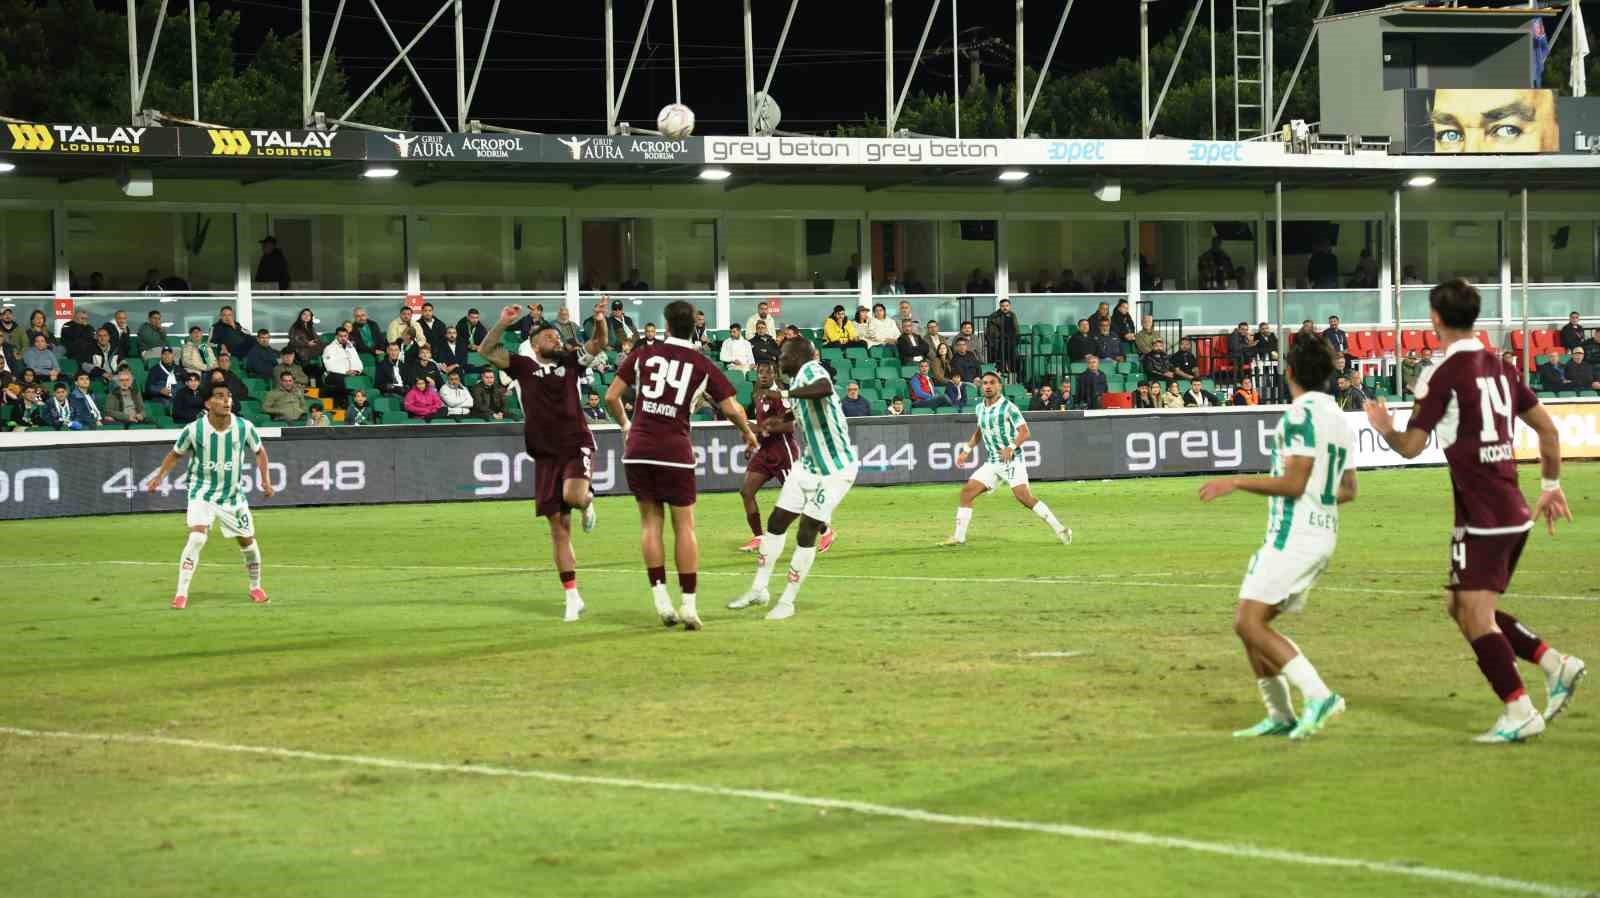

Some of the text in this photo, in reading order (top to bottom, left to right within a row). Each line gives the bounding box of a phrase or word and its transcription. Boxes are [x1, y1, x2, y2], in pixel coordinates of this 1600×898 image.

[53, 125, 147, 144] TALAY
[250, 130, 337, 148] TALAY
[60, 143, 141, 153] LOGISTICS
[257, 148, 332, 157] LOGISTICS
[412, 143, 456, 158] AURA
[461, 138, 524, 151] ACROPOL
[584, 145, 624, 159] AURA
[631, 140, 688, 153] ACROPOL
[712, 138, 850, 160] grey beton
[866, 140, 998, 161] grey beton
[641, 355, 694, 406] 34
[1476, 374, 1513, 442] 14
[1125, 427, 1242, 470] grey
[300, 460, 366, 491] 48
[473, 449, 615, 497] gry
